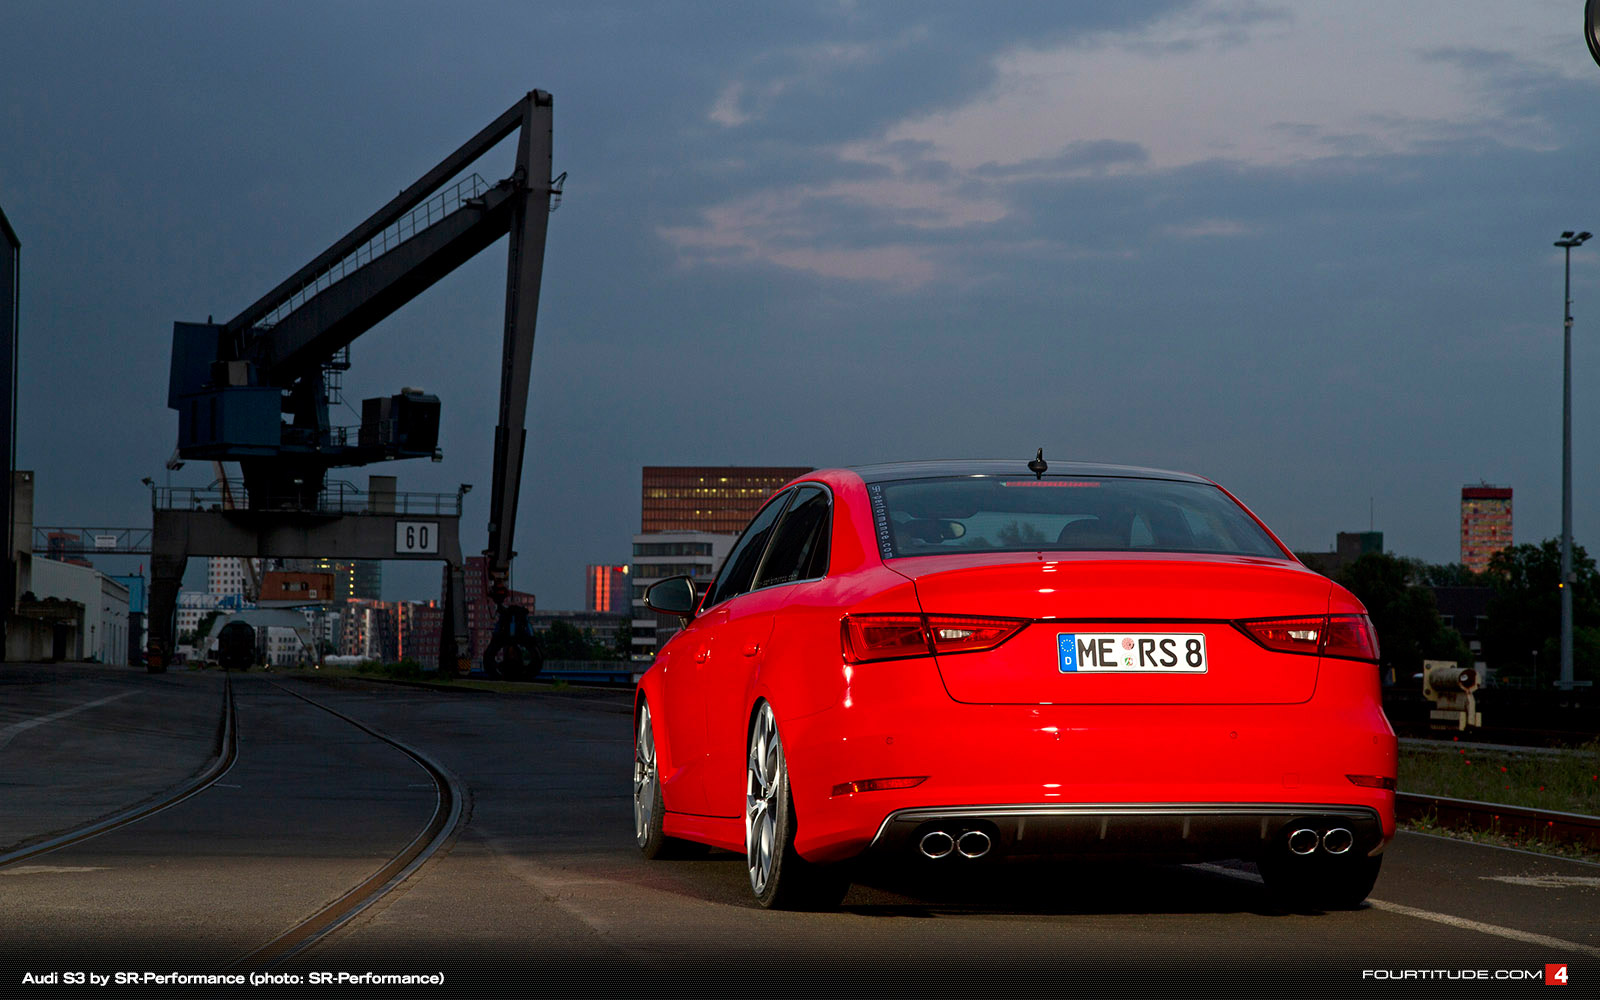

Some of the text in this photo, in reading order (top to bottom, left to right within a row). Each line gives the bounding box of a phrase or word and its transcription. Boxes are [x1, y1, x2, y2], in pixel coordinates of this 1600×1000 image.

[406, 525, 429, 550] 60
[1064, 656, 1072, 665] D
[1077, 638, 1203, 668] ME RS 8
